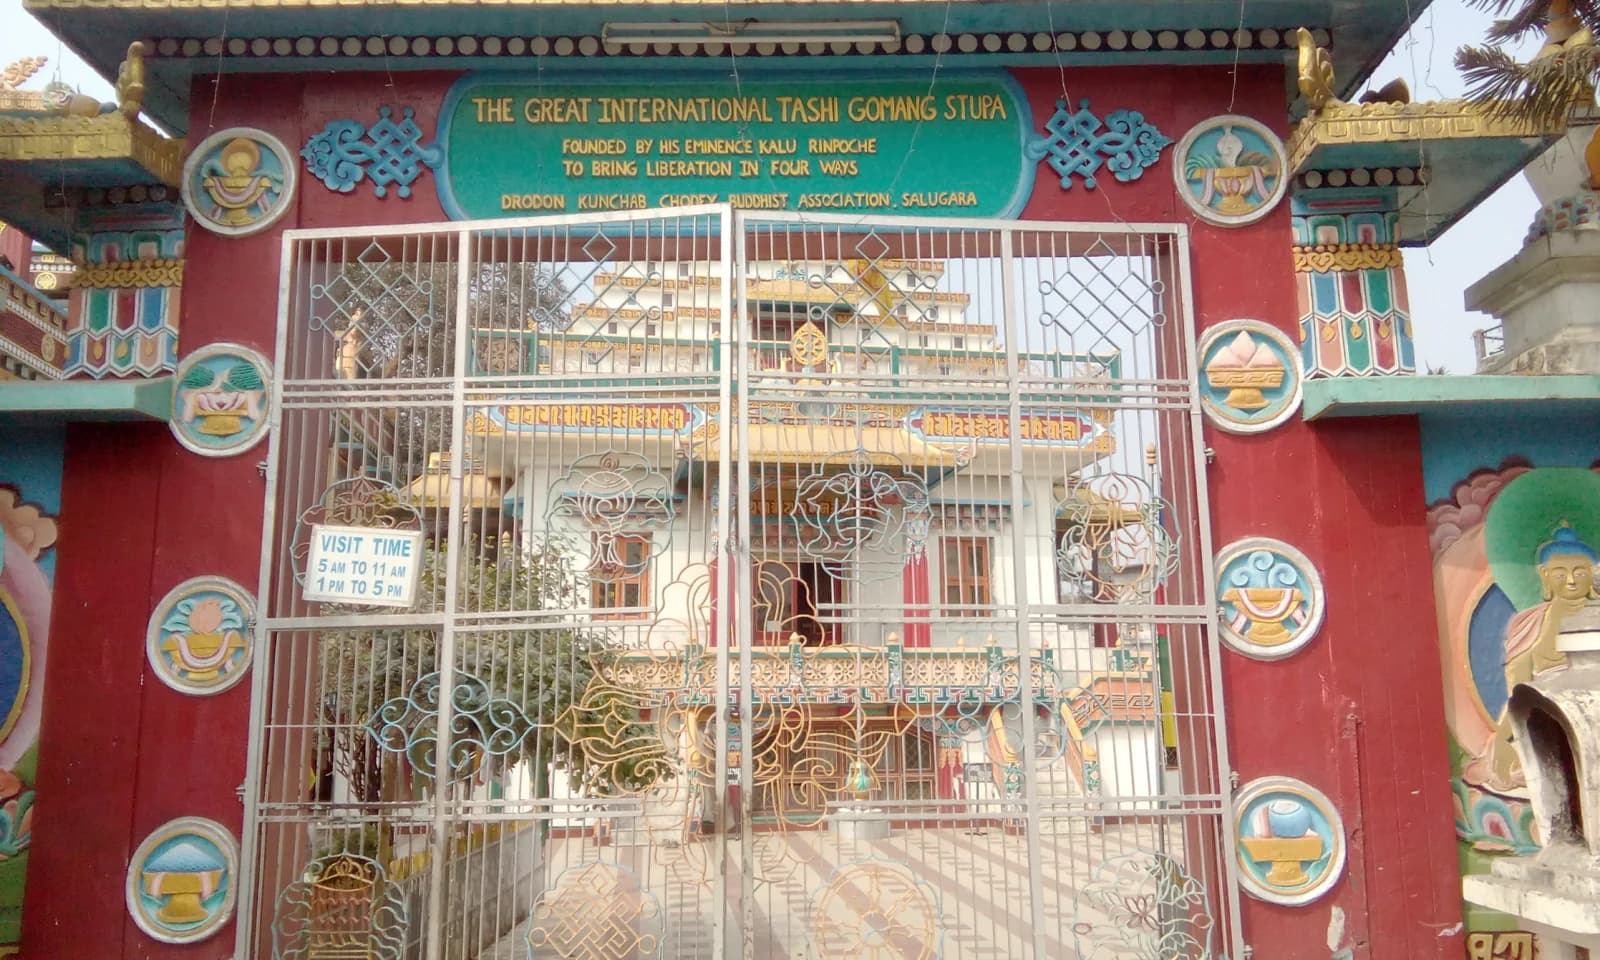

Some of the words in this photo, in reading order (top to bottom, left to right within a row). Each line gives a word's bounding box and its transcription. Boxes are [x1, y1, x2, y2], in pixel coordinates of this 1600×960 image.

[472, 98, 515, 123] THE
[524, 98, 593, 123] GREAT
[597, 97, 773, 123] INTERNATIONAL
[776, 96, 840, 123] TASHI
[848, 95, 937, 122] GOMANG
[944, 94, 1007, 121] STUPA
[562, 139, 627, 155] FOUNDED
[635, 139, 654, 155] BY
[660, 139, 680, 155] HIS
[685, 139, 753, 154] EMINENCE
[759, 139, 797, 154] KALU
[808, 138, 877, 154] RINPOCHE
[563, 161, 584, 176] TO
[592, 161, 638, 176] BRING
[646, 161, 732, 176] LIBERATION
[740, 160, 759, 176] IN
[771, 160, 810, 176] FOUR
[820, 160, 859, 175] WAYS
[501, 194, 565, 210] DRODON
[578, 194, 647, 209] KUNCHAB
[659, 193, 718, 208] CHODEY
[728, 193, 788, 209] BUDDHIST
[902, 192, 977, 207] SALUGARA
[321, 534, 363, 554] VISIT
[373, 537, 412, 557] TIME
[318, 558, 328, 573] 5
[330, 562, 346, 574] AM
[351, 561, 367, 575] TO
[372, 562, 386, 576] 11
[390, 566, 406, 577] AM
[317, 577, 325, 592] 1
[329, 580, 344, 593] PM
[351, 580, 367, 594] TO
[372, 580, 384, 595] 5
[387, 585, 402, 597] PM
